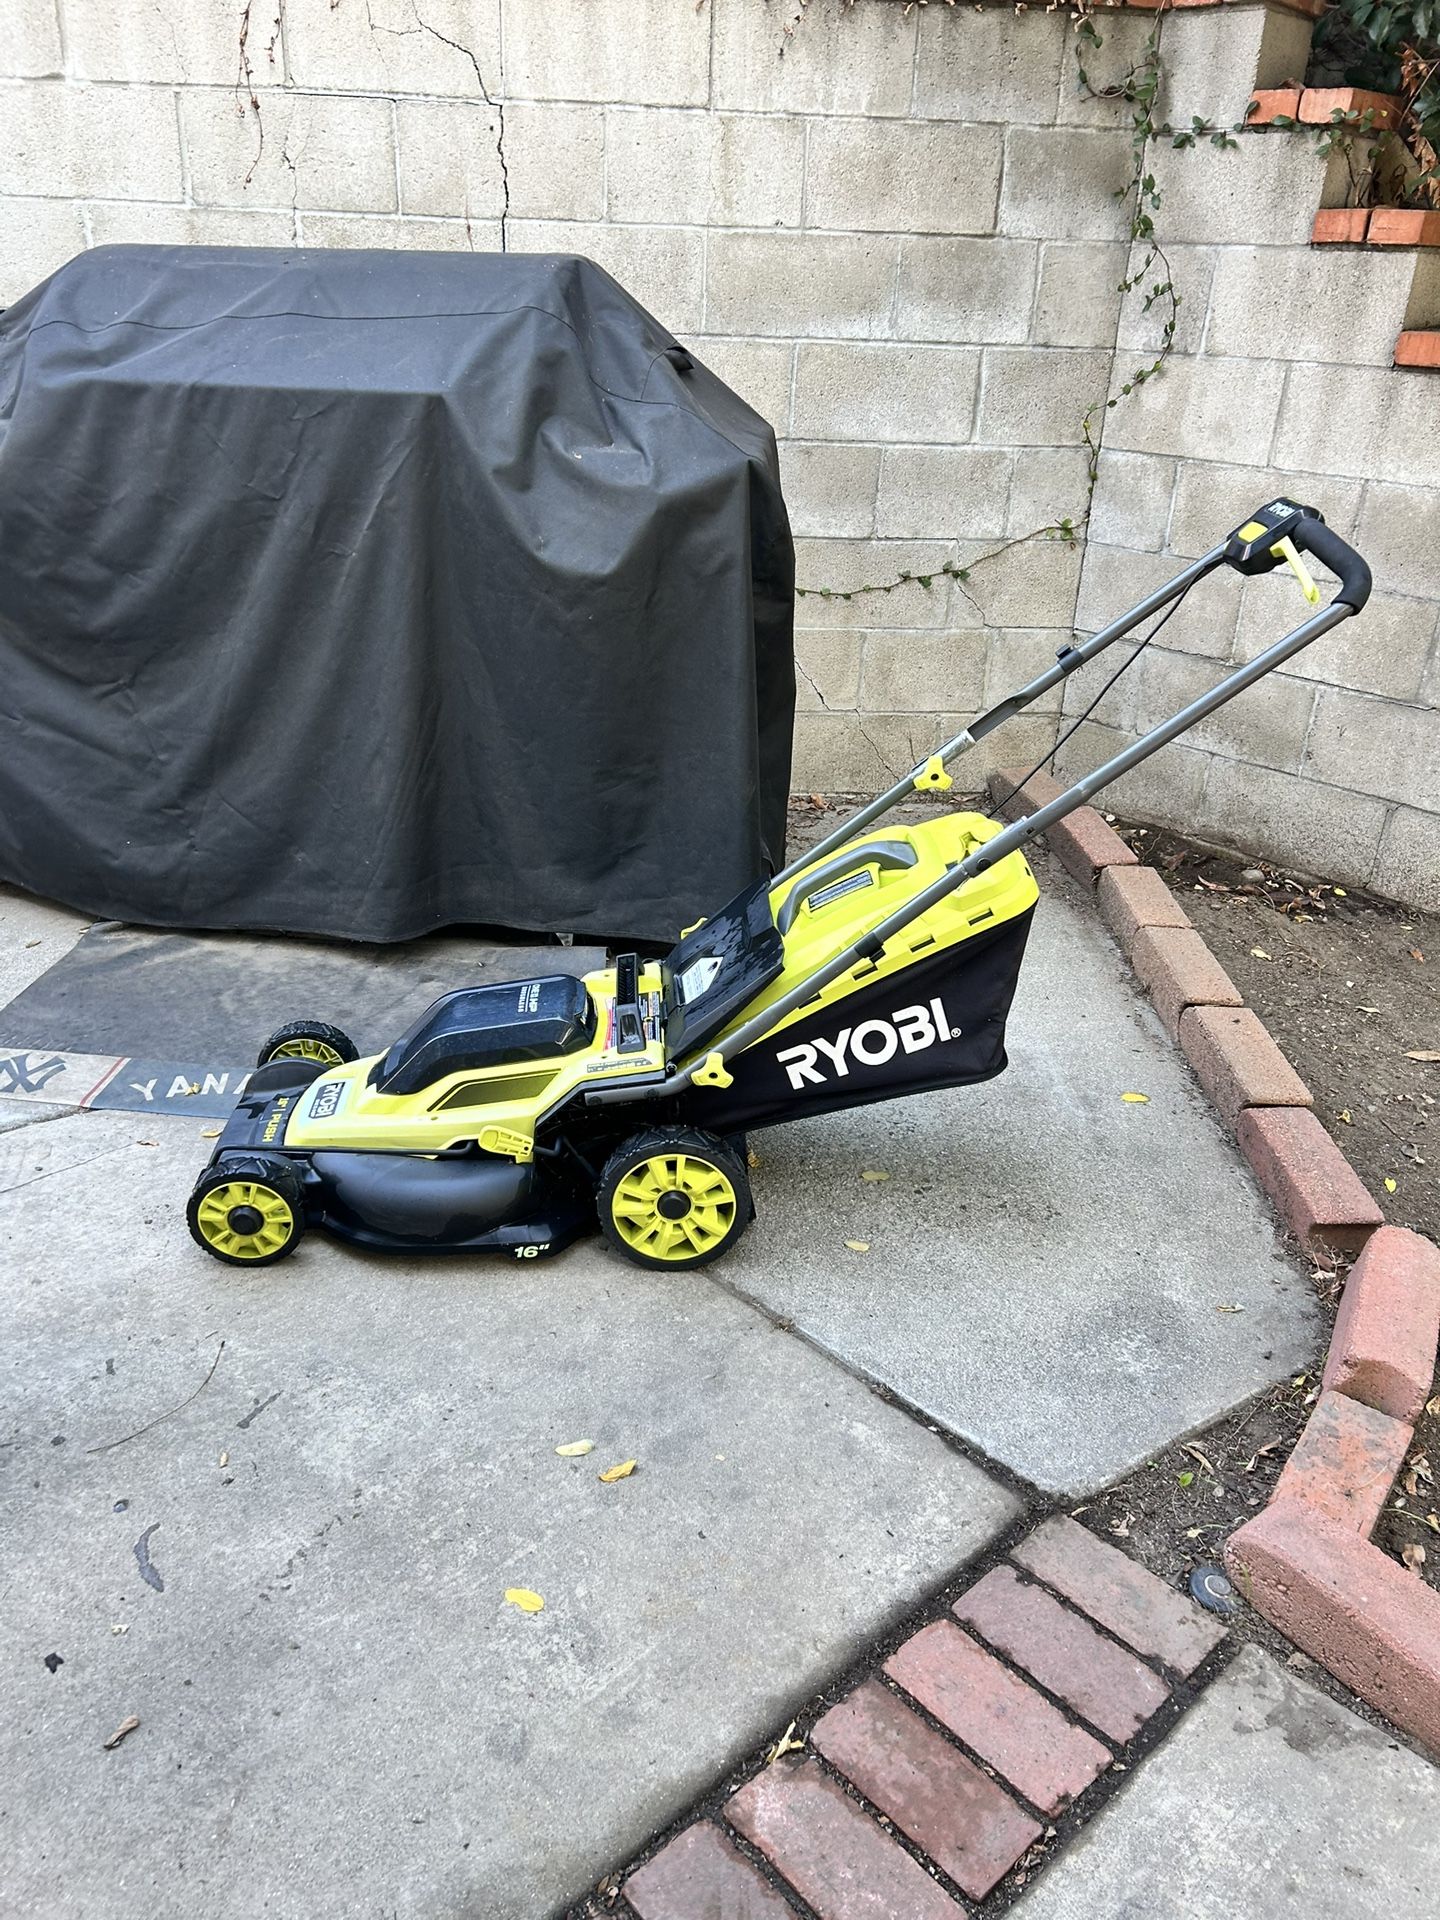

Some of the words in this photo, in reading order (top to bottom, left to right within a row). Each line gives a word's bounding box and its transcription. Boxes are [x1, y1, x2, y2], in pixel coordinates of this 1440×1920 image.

[315, 1083, 343, 1117] RYOBI
[262, 1113, 282, 1143] PUSH
[514, 1243, 550, 1258] 16"
